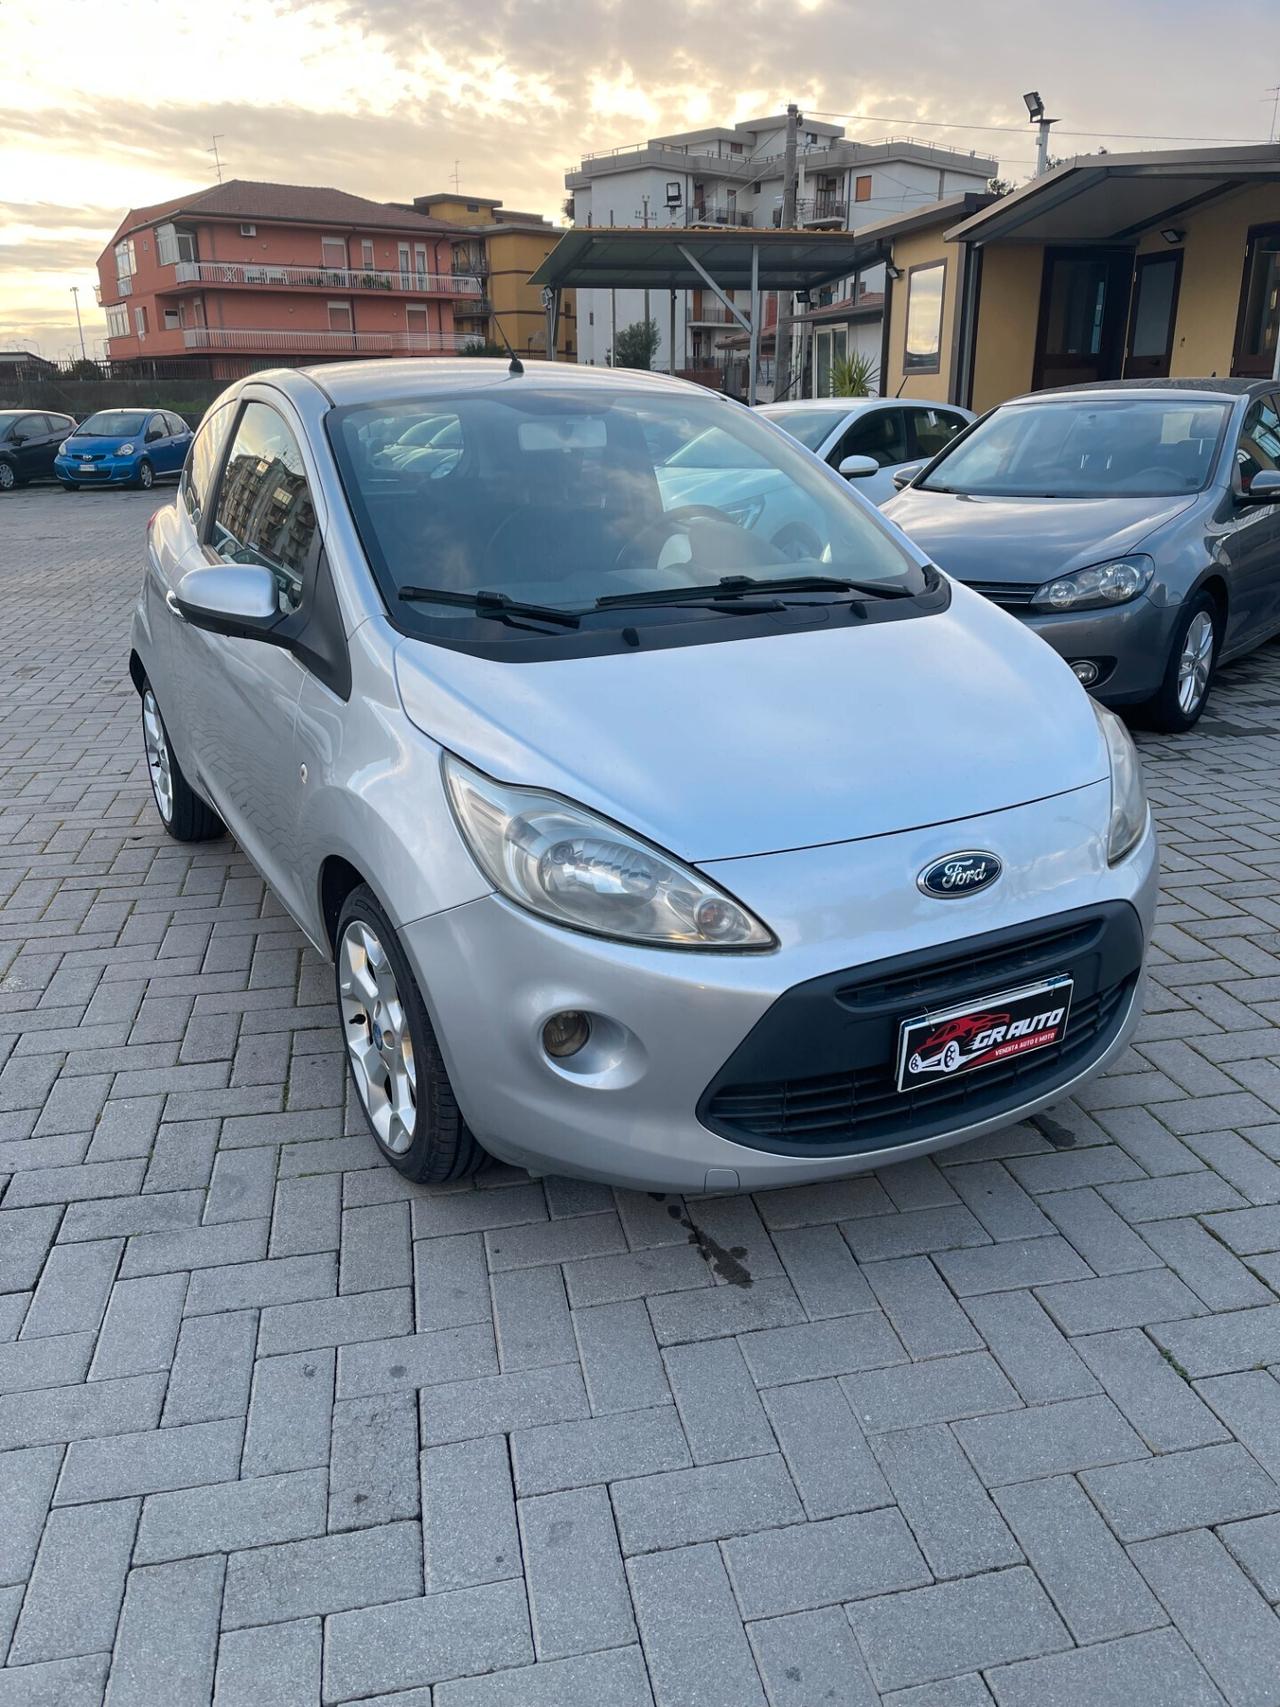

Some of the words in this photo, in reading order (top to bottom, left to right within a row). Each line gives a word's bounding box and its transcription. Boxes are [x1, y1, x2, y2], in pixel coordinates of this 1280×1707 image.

[941, 859, 987, 889] Ford
[972, 1025, 1007, 1050] GR
[1006, 1007, 1066, 1040] AUTO
[995, 1043, 1019, 1056] VENDITA
[1019, 1038, 1034, 1049] AUTO
[1039, 1032, 1055, 1043] MOTO
